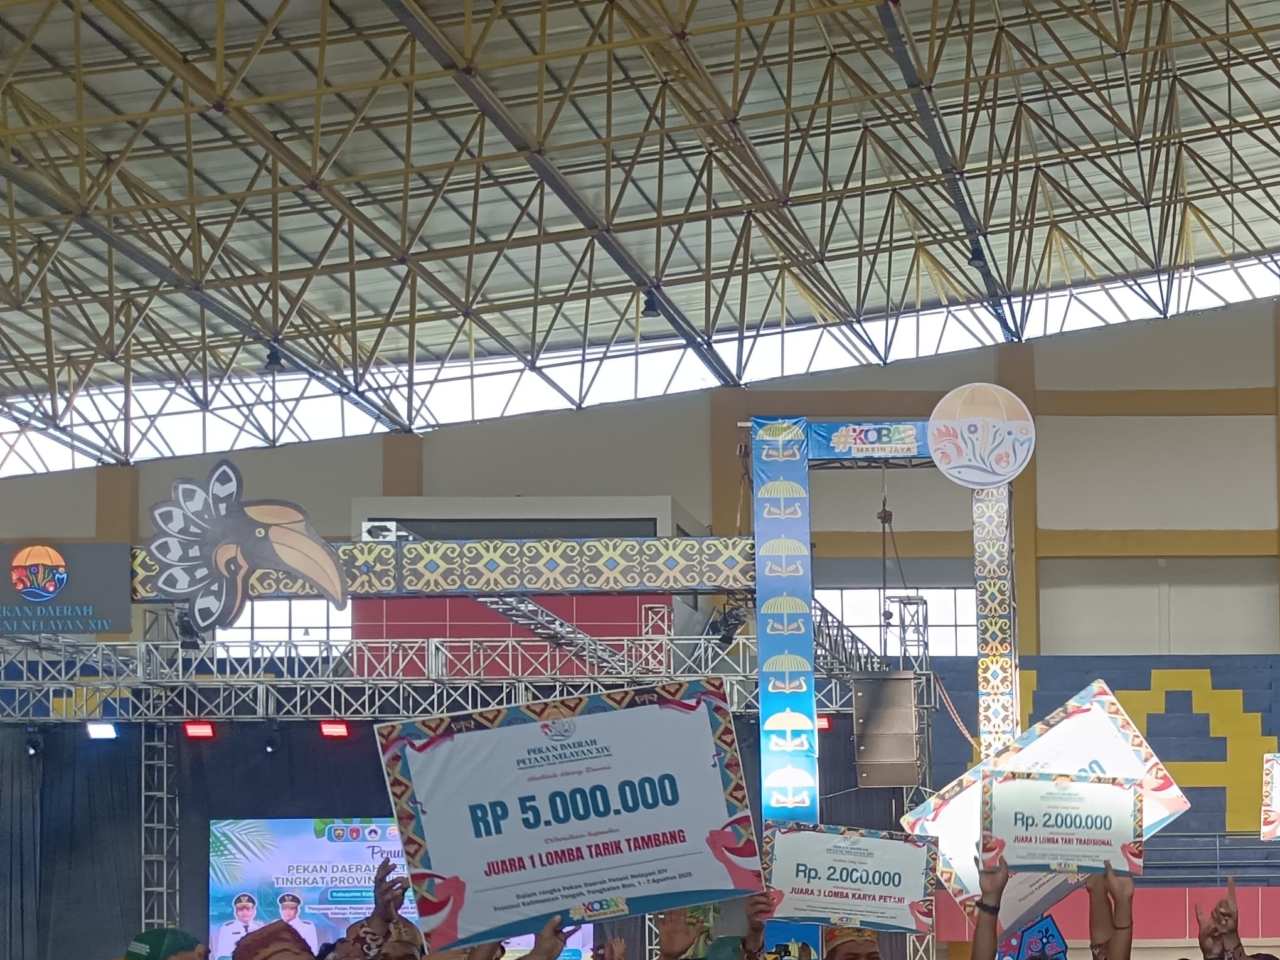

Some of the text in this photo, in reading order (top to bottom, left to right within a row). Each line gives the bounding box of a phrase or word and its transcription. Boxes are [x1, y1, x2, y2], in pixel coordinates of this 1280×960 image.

[857, 446, 887, 454] MAKIN
[37, 606, 93, 617] DAERAH
[22, 620, 84, 631] NELAYAN
[89, 620, 111, 631] XIV
[516, 754, 551, 767] PETANI
[551, 749, 594, 761] NELAYAN
[594, 745, 611, 755] XIV
[527, 739, 598, 756] PEKAN DAERAH
[468, 773, 680, 839] RP 5.000.000
[1014, 812, 1112, 832] Rp. 2.000.000
[1013, 836, 1032, 844] JUARA
[1039, 837, 1059, 845] LOMBA
[1061, 837, 1074, 845] TARI
[1075, 838, 1113, 847] TRADISIONAL
[484, 829, 687, 877] JUARA 1 LOMBA TARIK TAMBANG
[287, 864, 380, 874] PEKAN DAERAH
[795, 863, 902, 887] Rp. 2.000.000
[274, 876, 377, 886] TINGKAT PROVIN
[790, 887, 905, 904] JUARA 3 LOMBA KARYA PETANI
